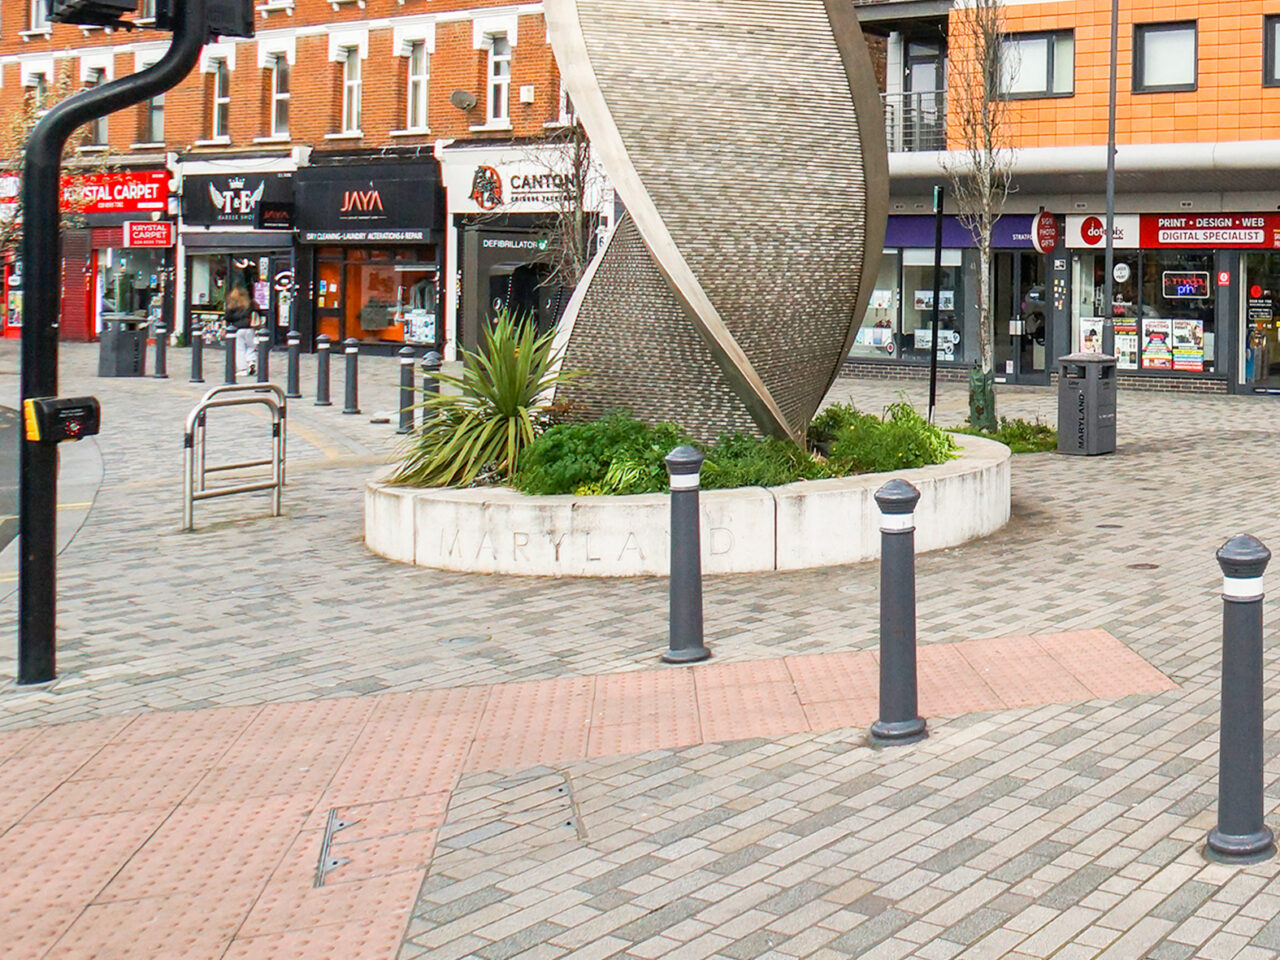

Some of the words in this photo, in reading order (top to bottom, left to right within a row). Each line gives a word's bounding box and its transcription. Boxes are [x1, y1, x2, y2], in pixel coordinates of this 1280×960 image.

[511, 174, 576, 189] CANTON
[114, 184, 159, 200] CARPET
[340, 190, 384, 212] JAYA
[1158, 218, 1187, 227] PRINT
[1196, 218, 1232, 227] DESIGN
[1242, 218, 1265, 227] WEB
[132, 231, 167, 239] CARPET
[1162, 231, 1200, 241] DIGITAL
[1203, 231, 1260, 240] SPECIALIST
[483, 240, 538, 248] DEFIBRILLATOR
[439, 527, 736, 562] MARYLAD
